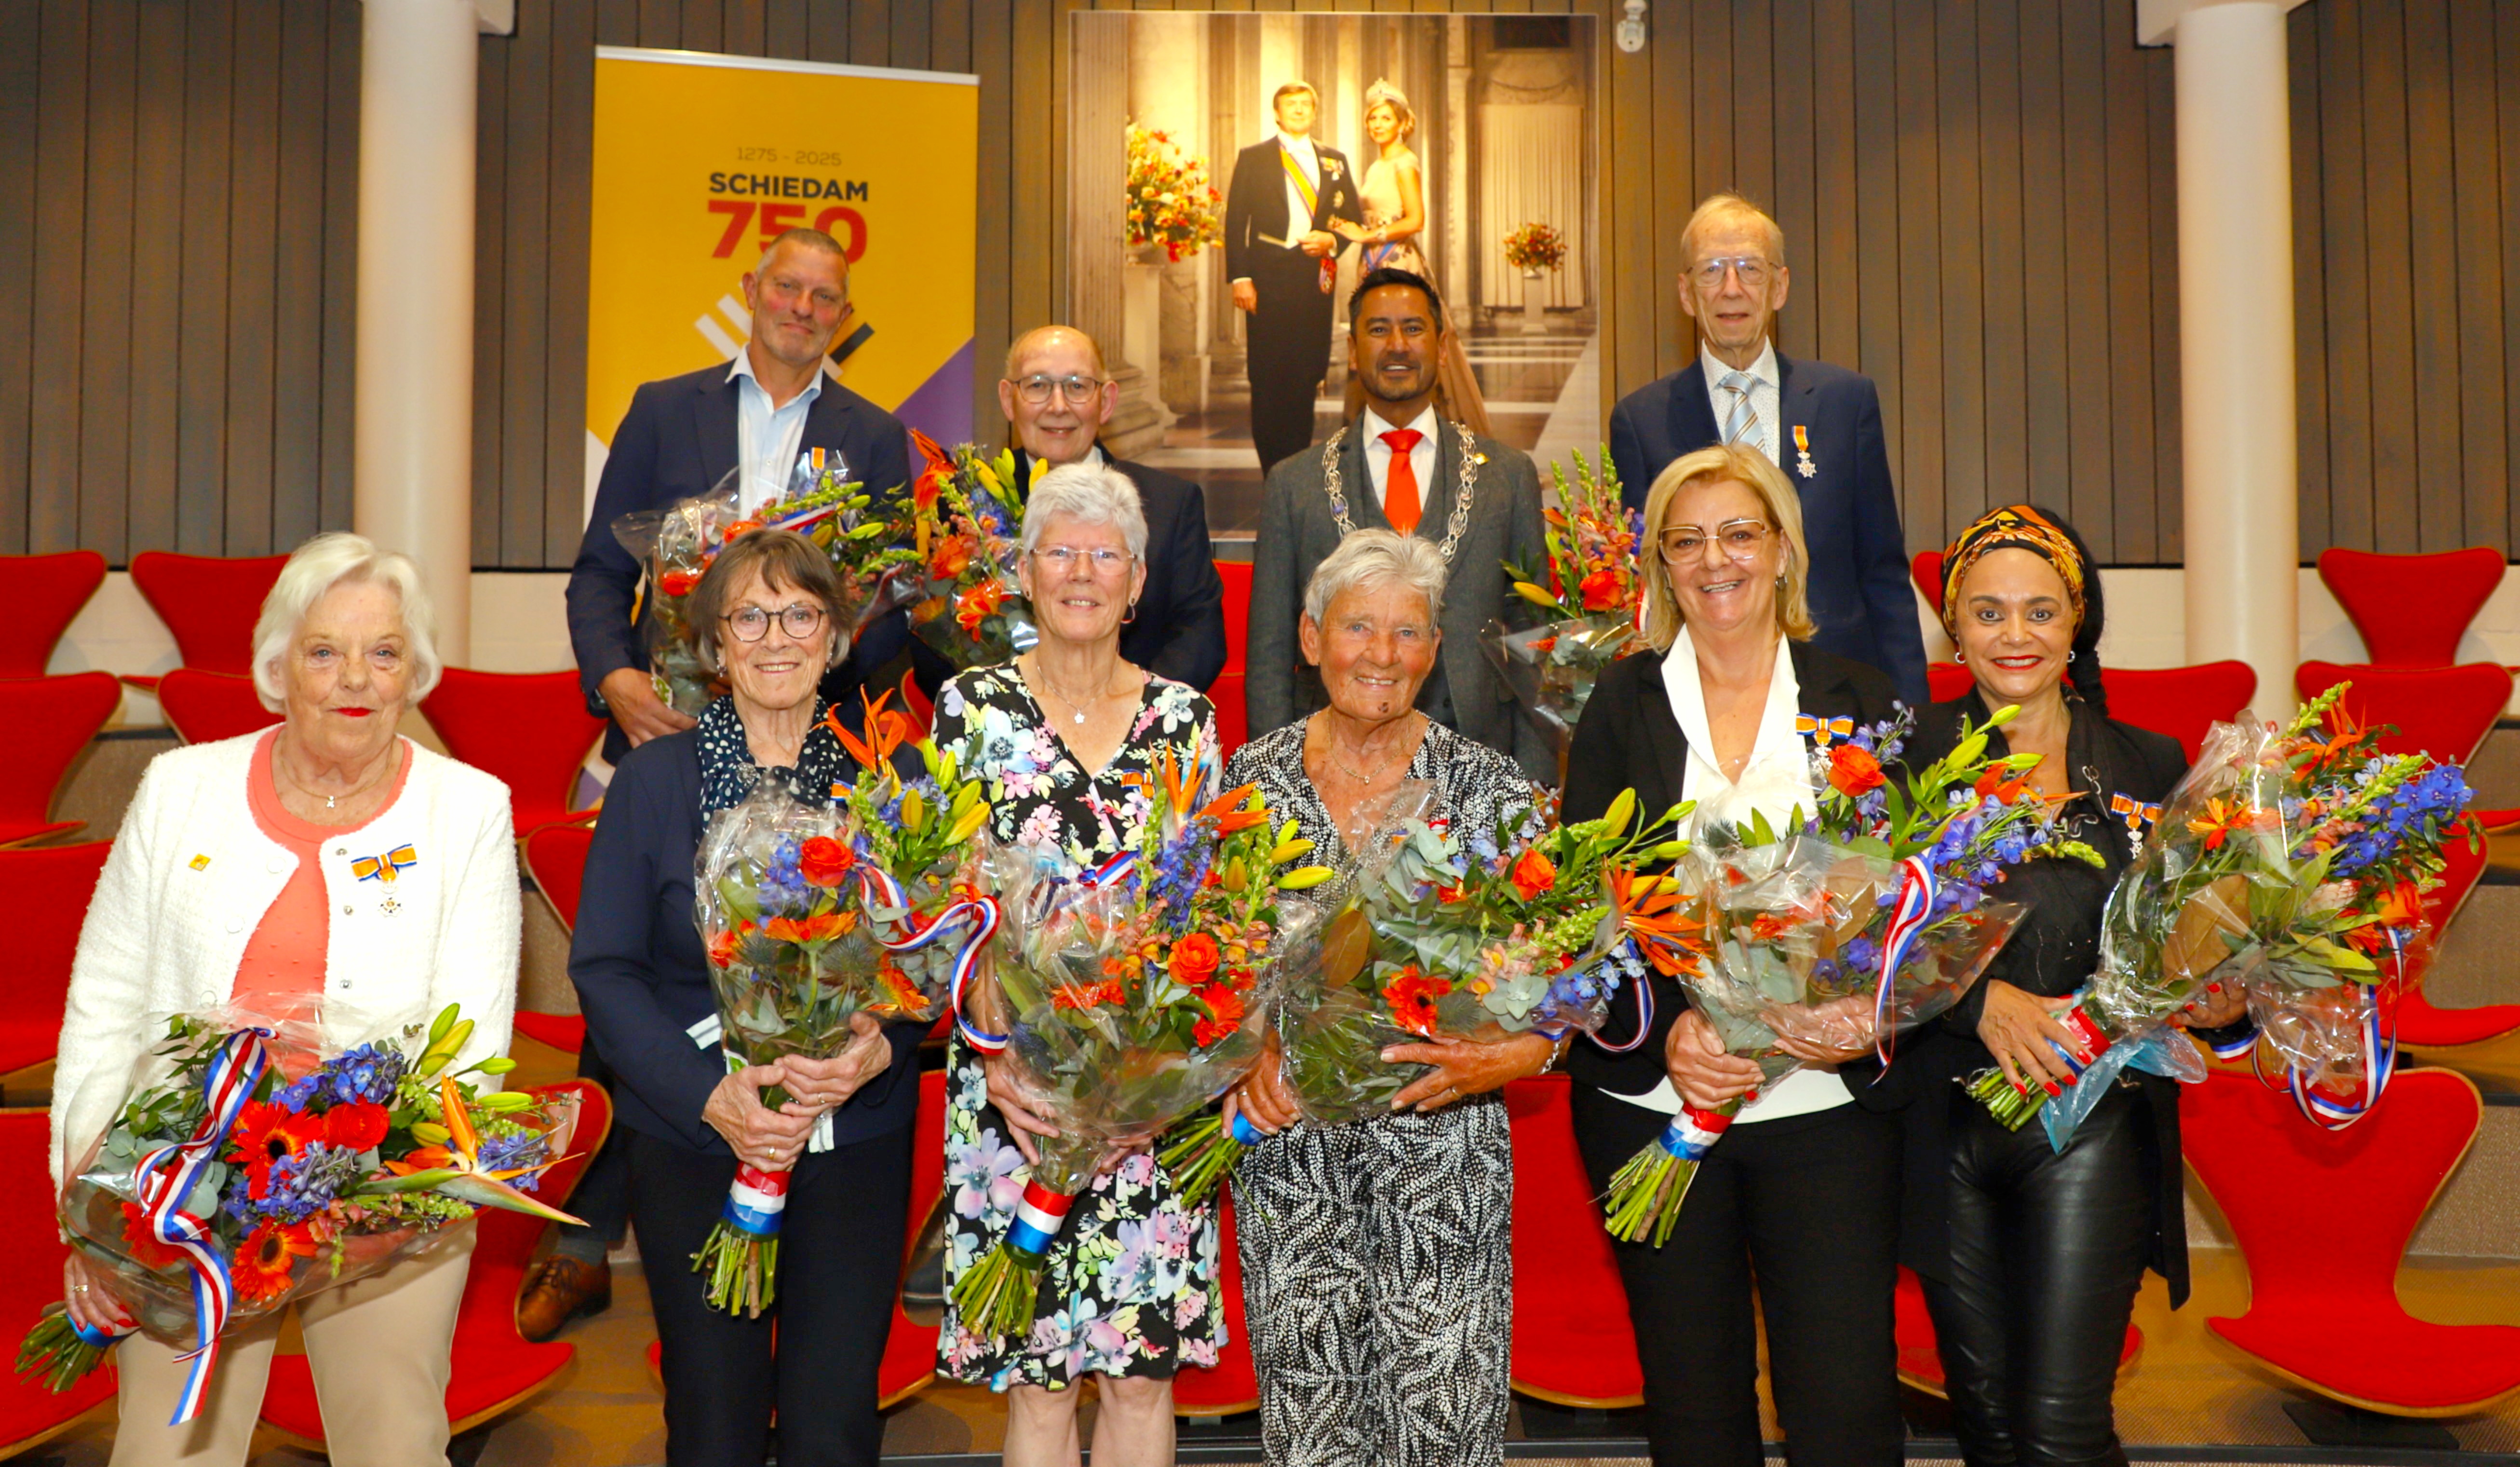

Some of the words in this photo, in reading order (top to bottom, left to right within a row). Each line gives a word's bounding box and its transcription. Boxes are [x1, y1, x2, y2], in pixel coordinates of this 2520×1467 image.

[737, 147, 778, 163] 1275
[795, 150, 842, 166] 2025
[709, 172, 868, 202] SCHIEDAM
